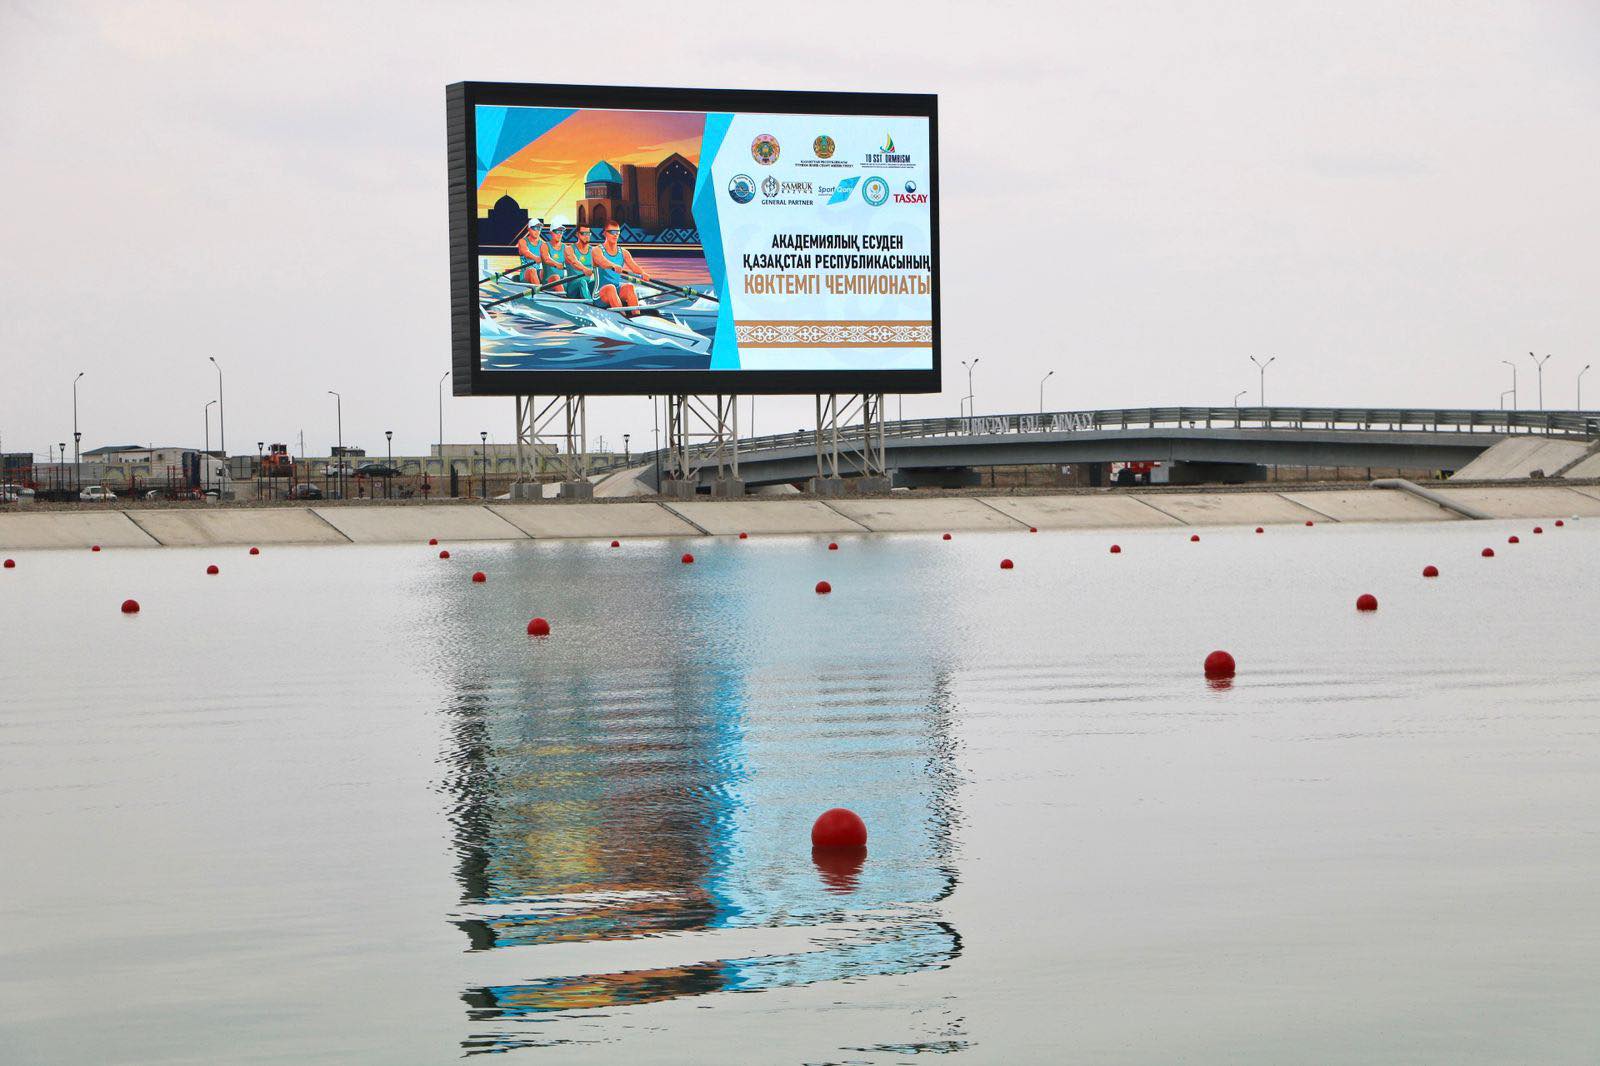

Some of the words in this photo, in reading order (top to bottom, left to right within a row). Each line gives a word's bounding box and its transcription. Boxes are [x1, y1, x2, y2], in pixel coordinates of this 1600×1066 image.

[781, 182, 813, 190] SAMRUK
[893, 194, 928, 204] TASSAY
[771, 234, 860, 252] АКАДЕМИЯЛЫҚ
[862, 235, 904, 251] ЕСУДЕН
[743, 253, 812, 272] ҚАЗАҚСТАН
[815, 254, 931, 272] РЕСПУБЛИКАСЫНЫҢ
[744, 273, 820, 295] КӨКТЕМГІ
[825, 274, 931, 295] ЧЕМПИОНАТЫ
